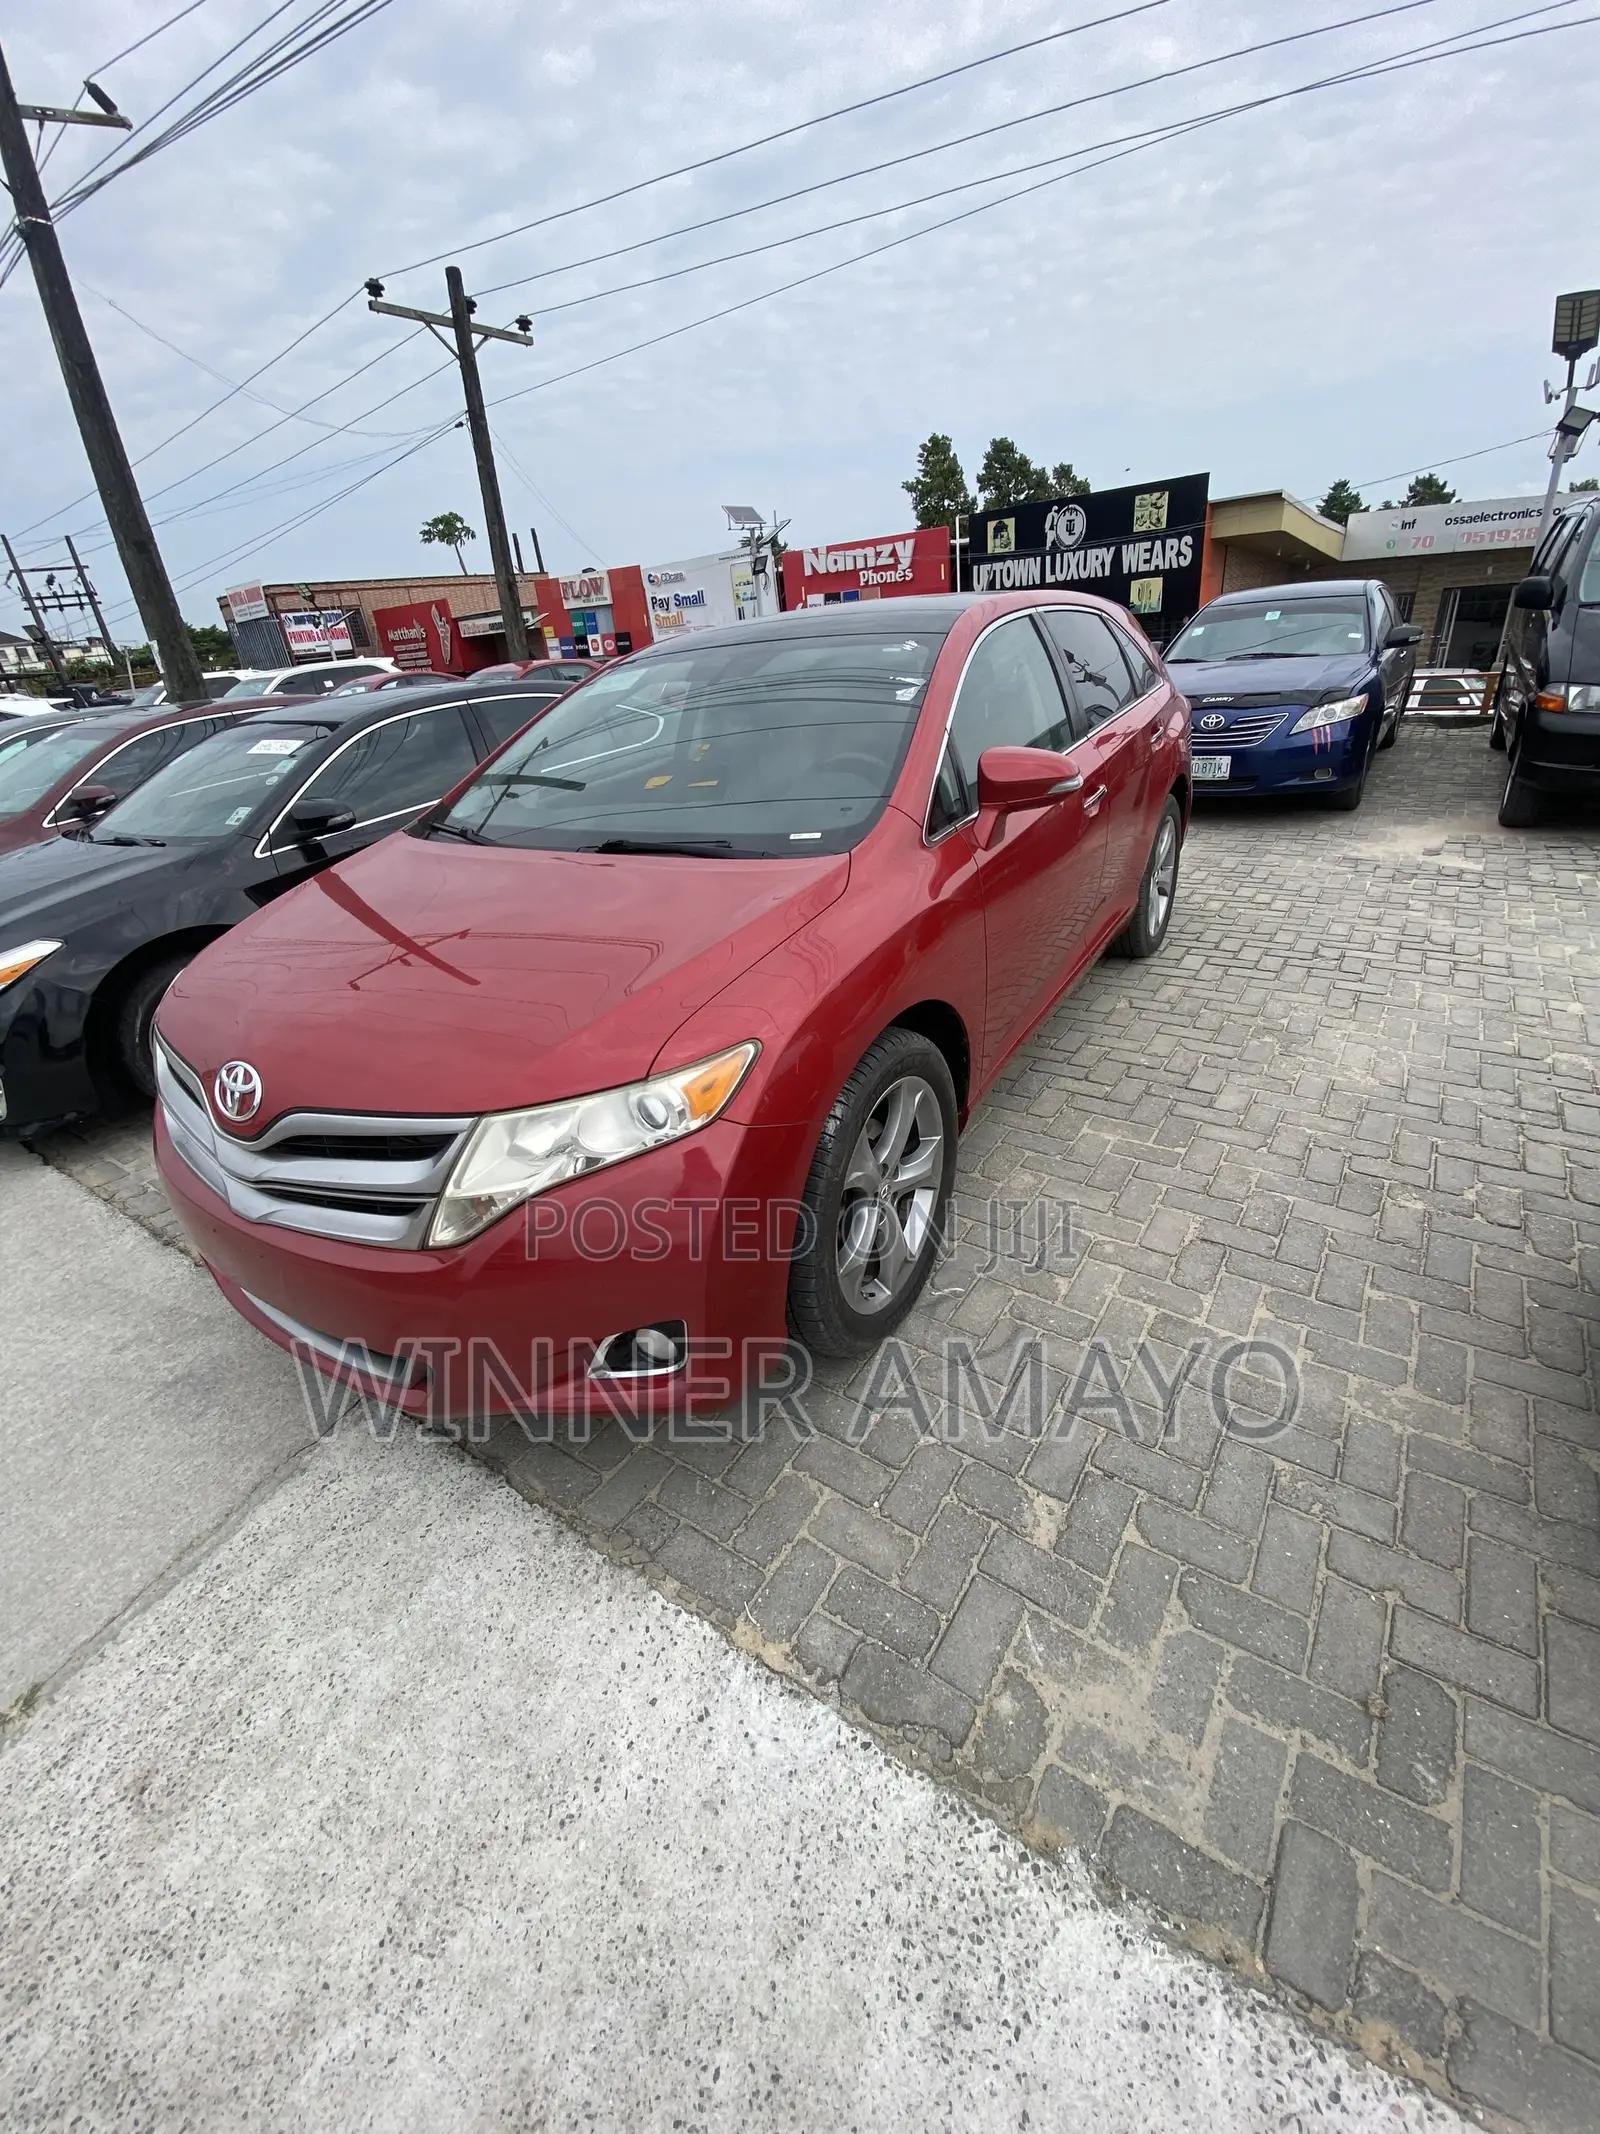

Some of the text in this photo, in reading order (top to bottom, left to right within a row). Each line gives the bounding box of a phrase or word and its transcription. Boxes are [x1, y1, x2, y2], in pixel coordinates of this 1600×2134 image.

[802, 538, 915, 577] Namzy
[973, 535, 1193, 591] UPTOWN LUXURY WEARS
[859, 568, 913, 586] Phones
[560, 577, 604, 600] FLOW
[651, 589, 705, 611] Pay Small
[655, 610, 685, 628] Small
